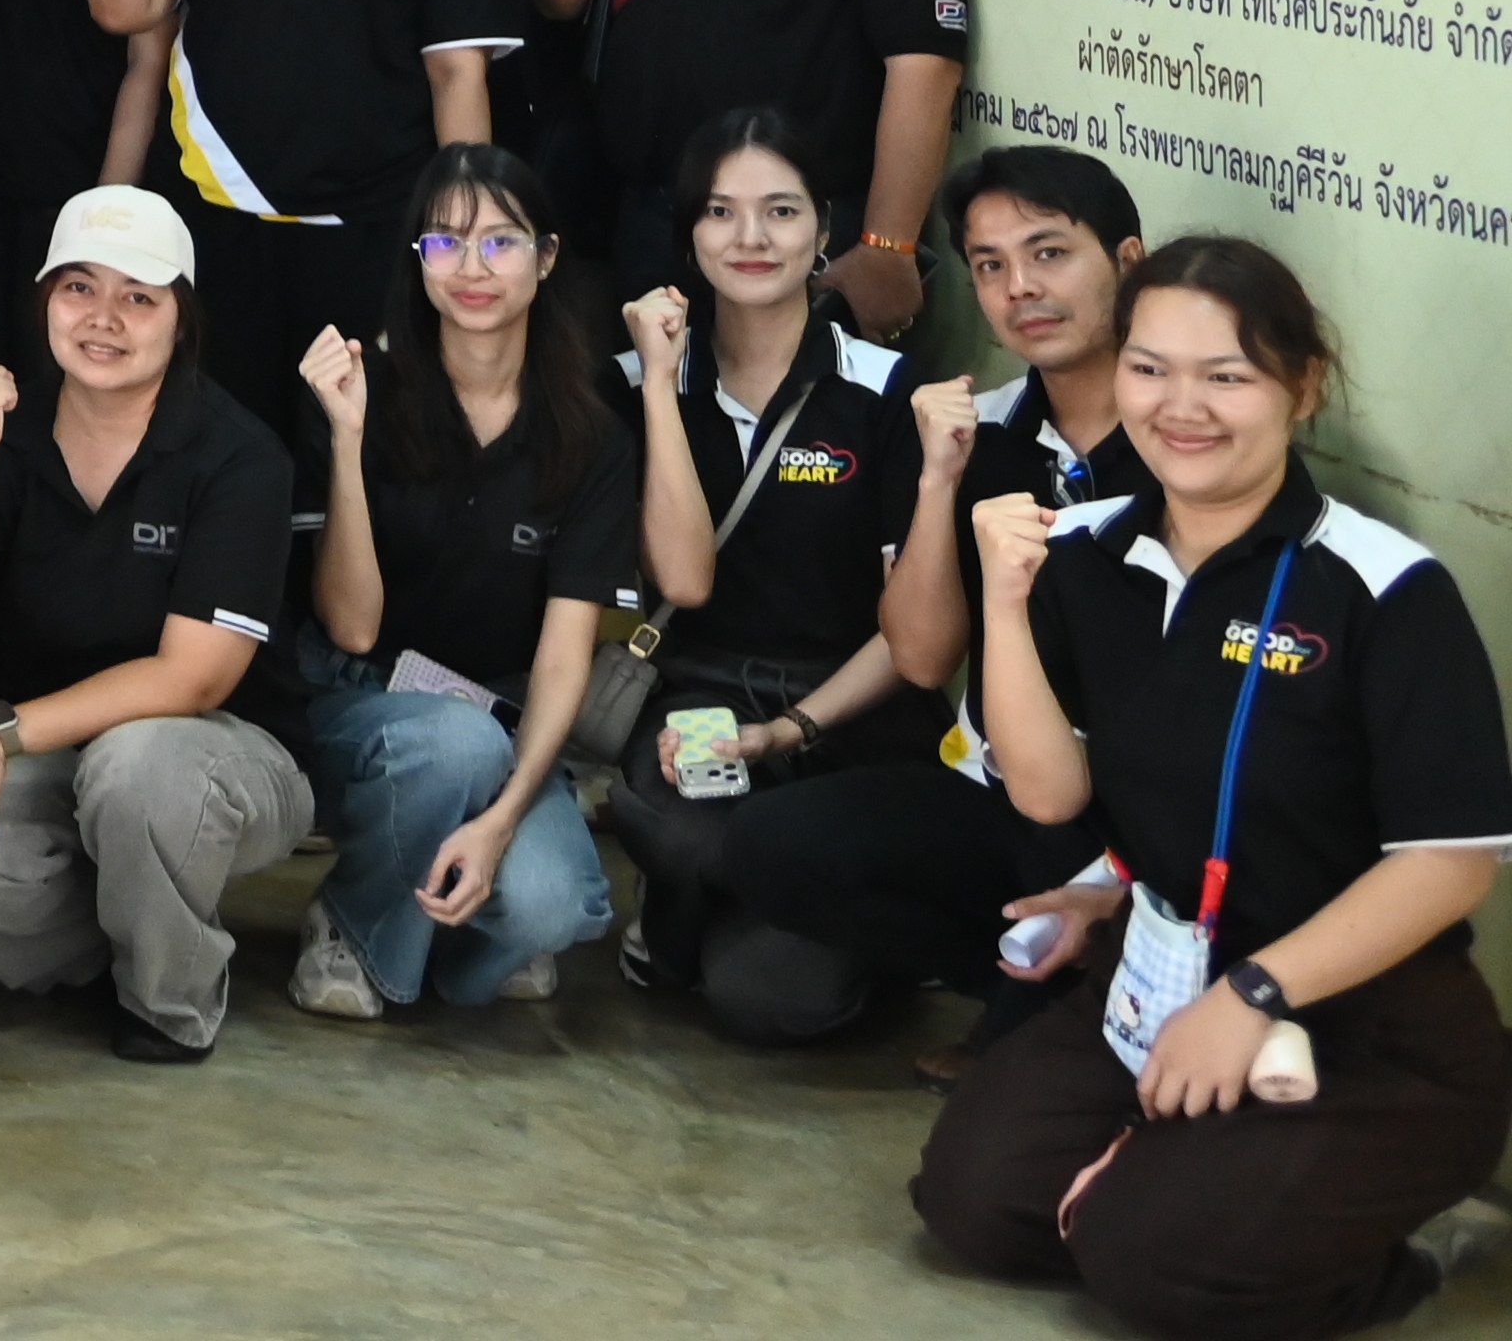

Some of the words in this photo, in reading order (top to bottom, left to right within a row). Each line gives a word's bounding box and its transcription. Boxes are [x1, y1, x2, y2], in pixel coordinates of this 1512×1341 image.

[1078, 26, 1264, 109] ผ่าตัดรักษาโรคตา
[1010, 97, 1079, 140] ๒๕๖๗
[1087, 116, 1109, 150] ณ
[1373, 163, 1512, 248] จังหวัดนค
[778, 465, 839, 484] HEART
